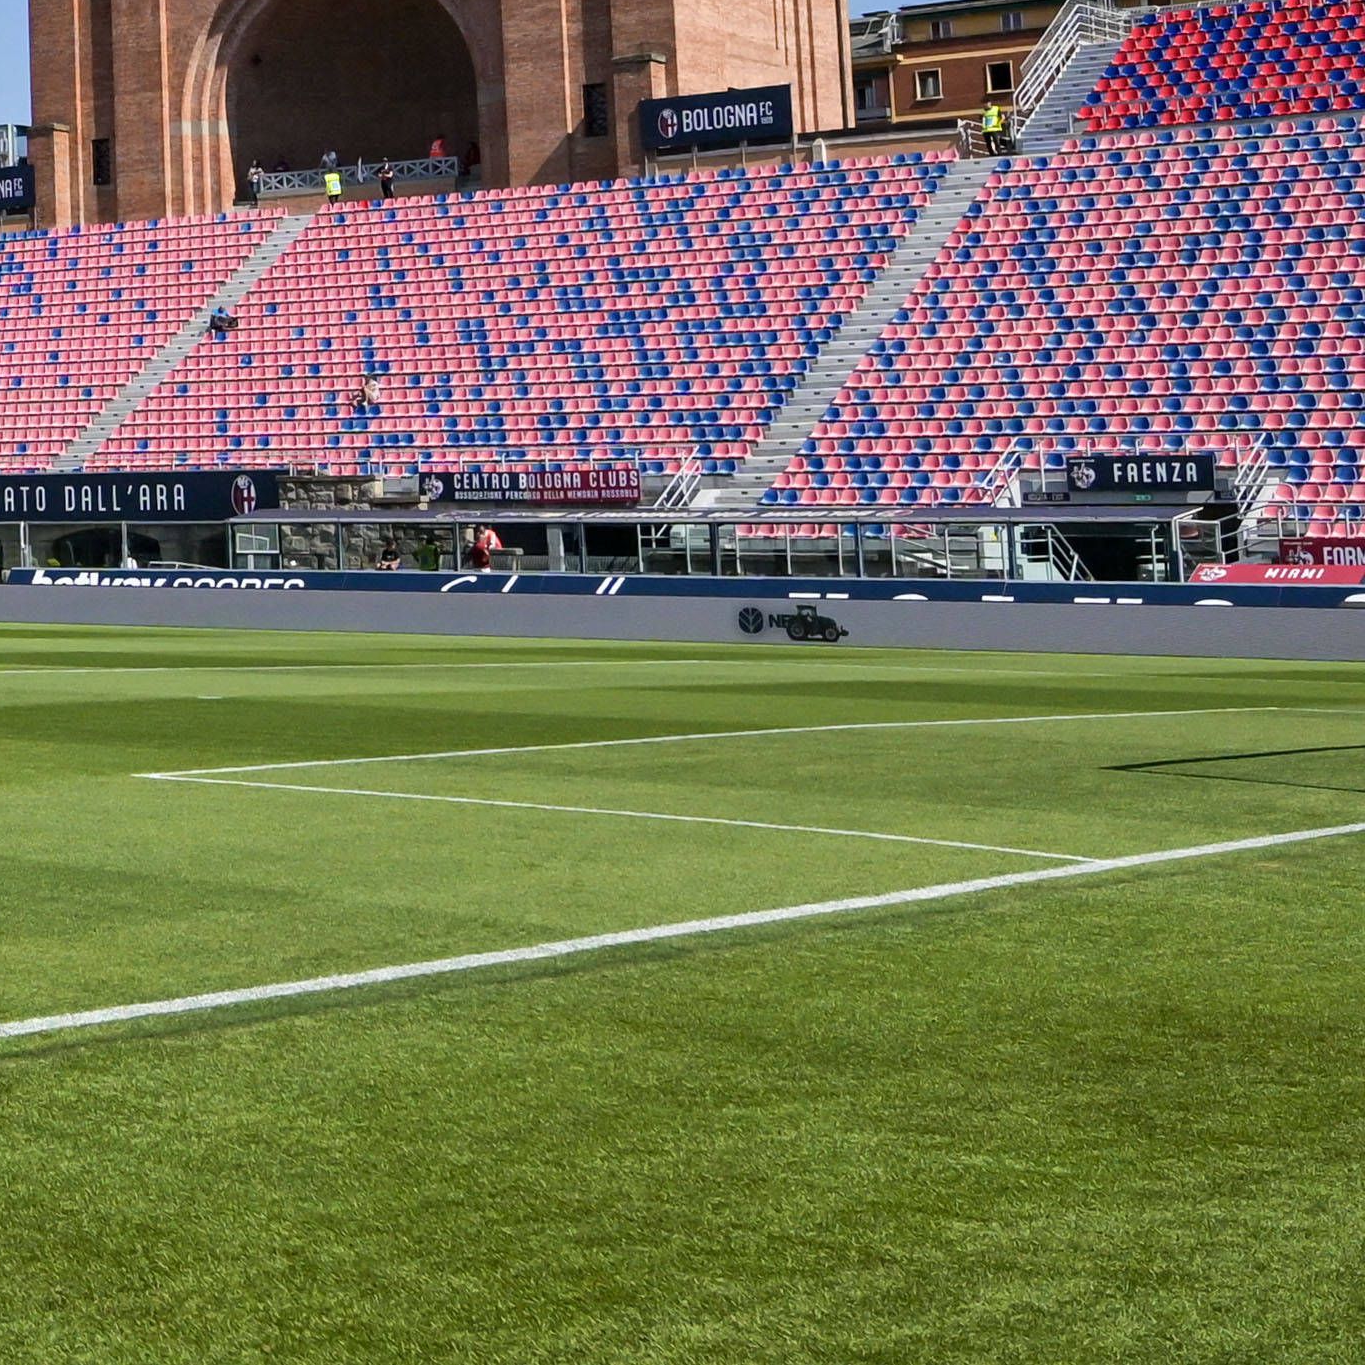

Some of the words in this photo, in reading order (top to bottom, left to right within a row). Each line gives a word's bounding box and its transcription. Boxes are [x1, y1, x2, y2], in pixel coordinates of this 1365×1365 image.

[682, 103, 758, 133] BOLOGNA
[759, 101, 773, 116] FC
[13, 177, 24, 190] FC
[454, 472, 509, 489] CENTRO
[519, 471, 581, 489] BOLOGNA
[589, 470, 638, 488] CLUBS
[1113, 462, 1197, 482] FAENZA
[64, 484, 185, 512] DALL'ARA
[1264, 568, 1325, 579] MIAMI
